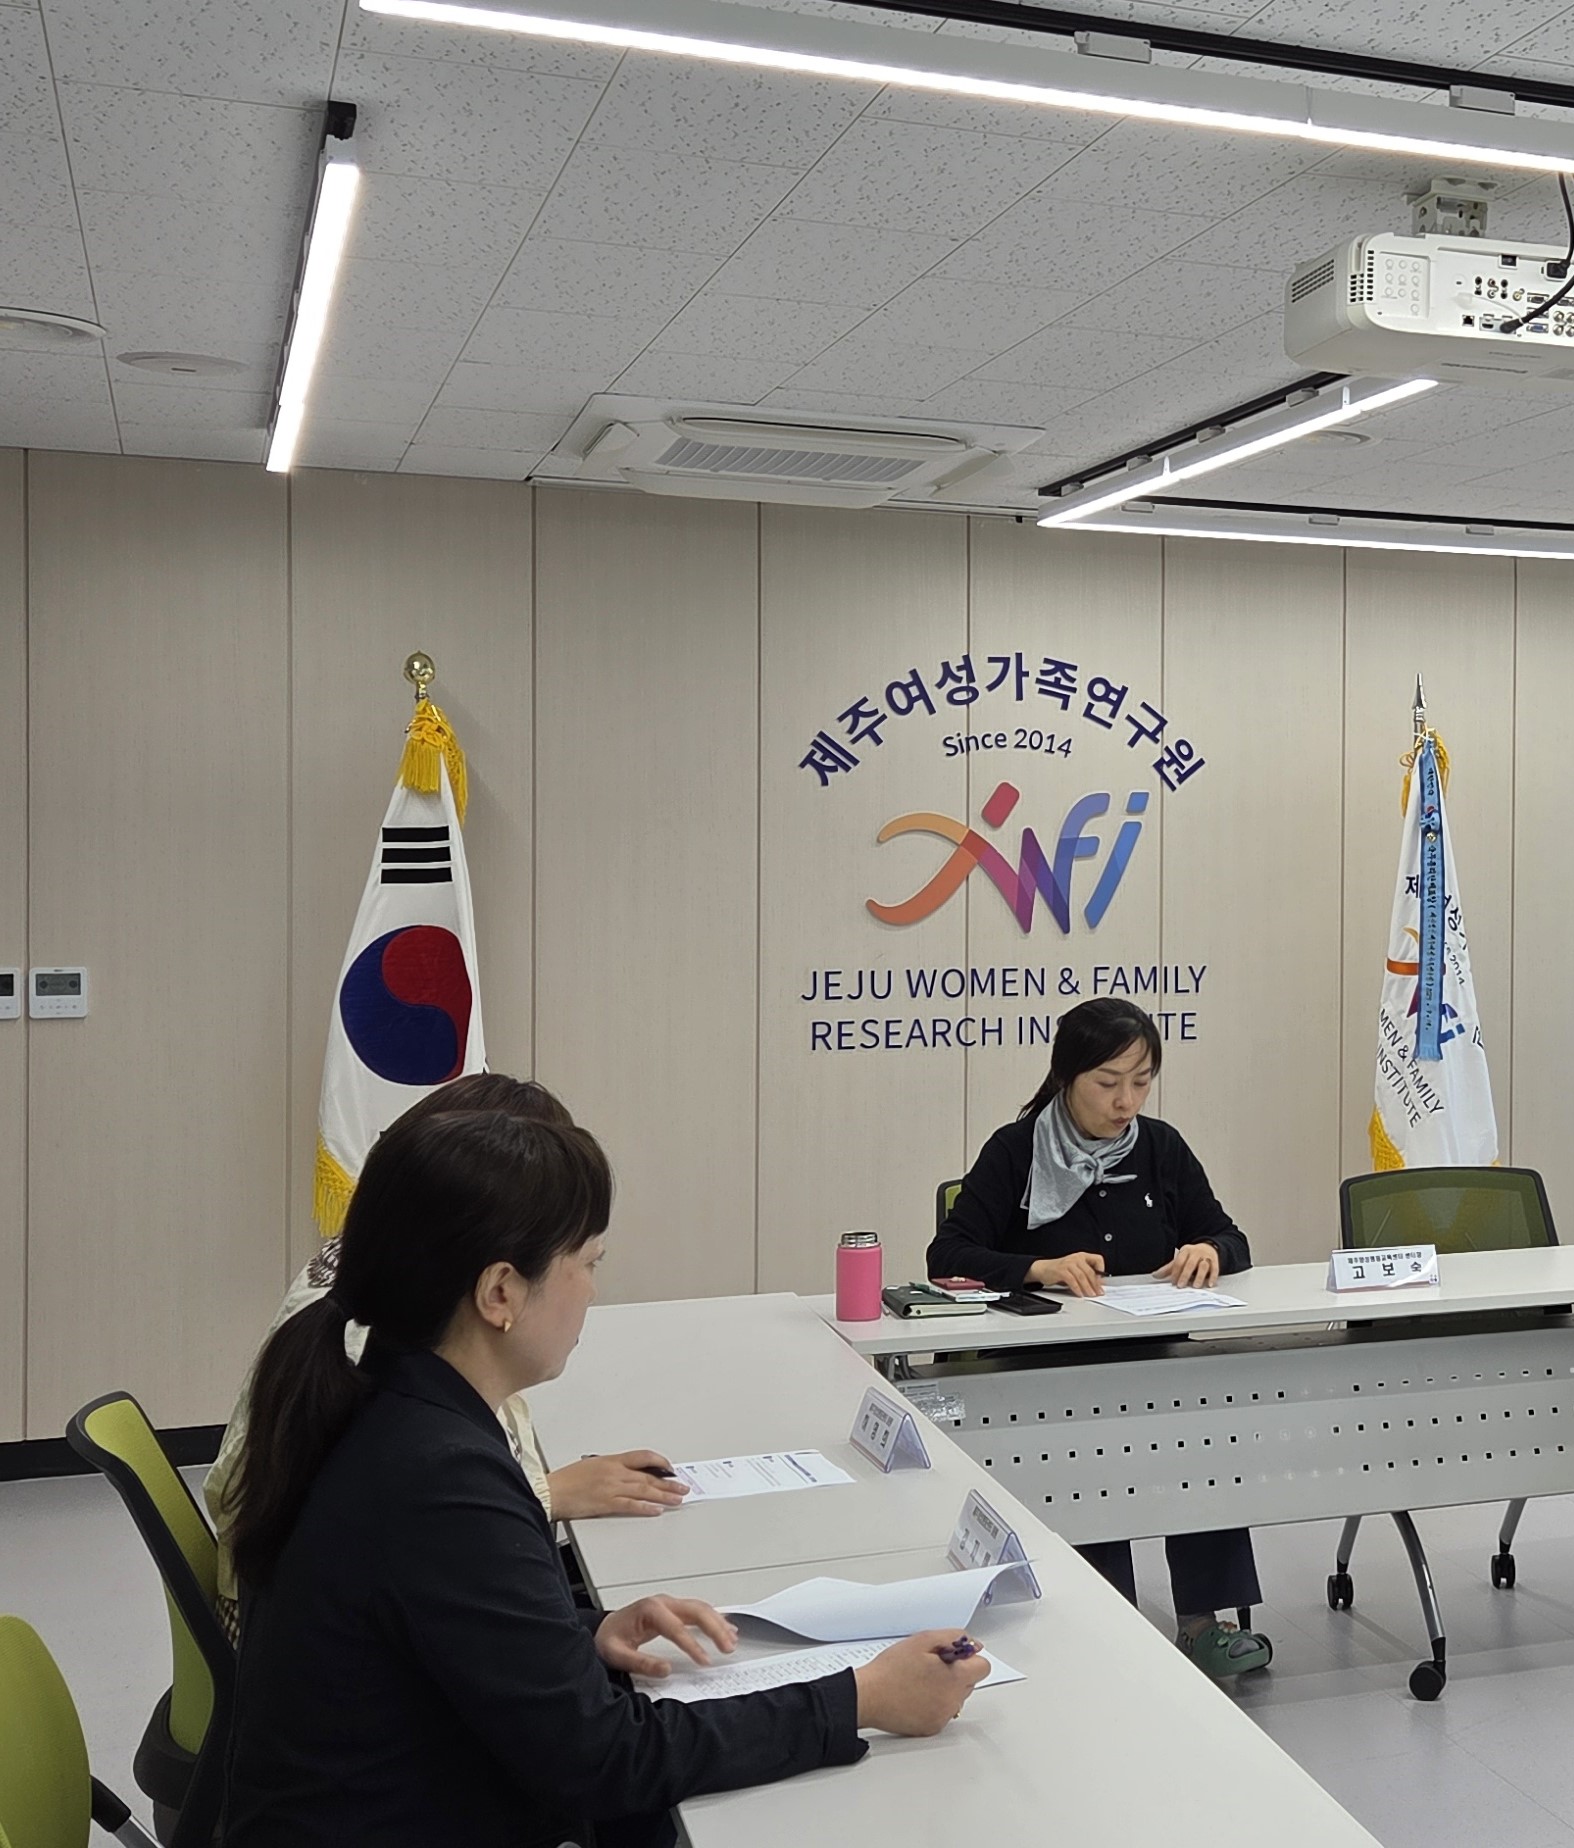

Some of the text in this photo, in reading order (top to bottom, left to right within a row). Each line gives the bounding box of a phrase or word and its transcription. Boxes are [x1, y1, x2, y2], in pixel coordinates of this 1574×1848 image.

[799, 652, 1206, 792] 제주여성가족연구원
[942, 728, 1074, 759] Since 2014
[801, 964, 1208, 1001] JEJU WOMEN & FAMILY
[811, 1016, 1002, 1051] RESEARCH
[1397, 1045, 1409, 1061] &
[1407, 1059, 1444, 1113] FAMILY
